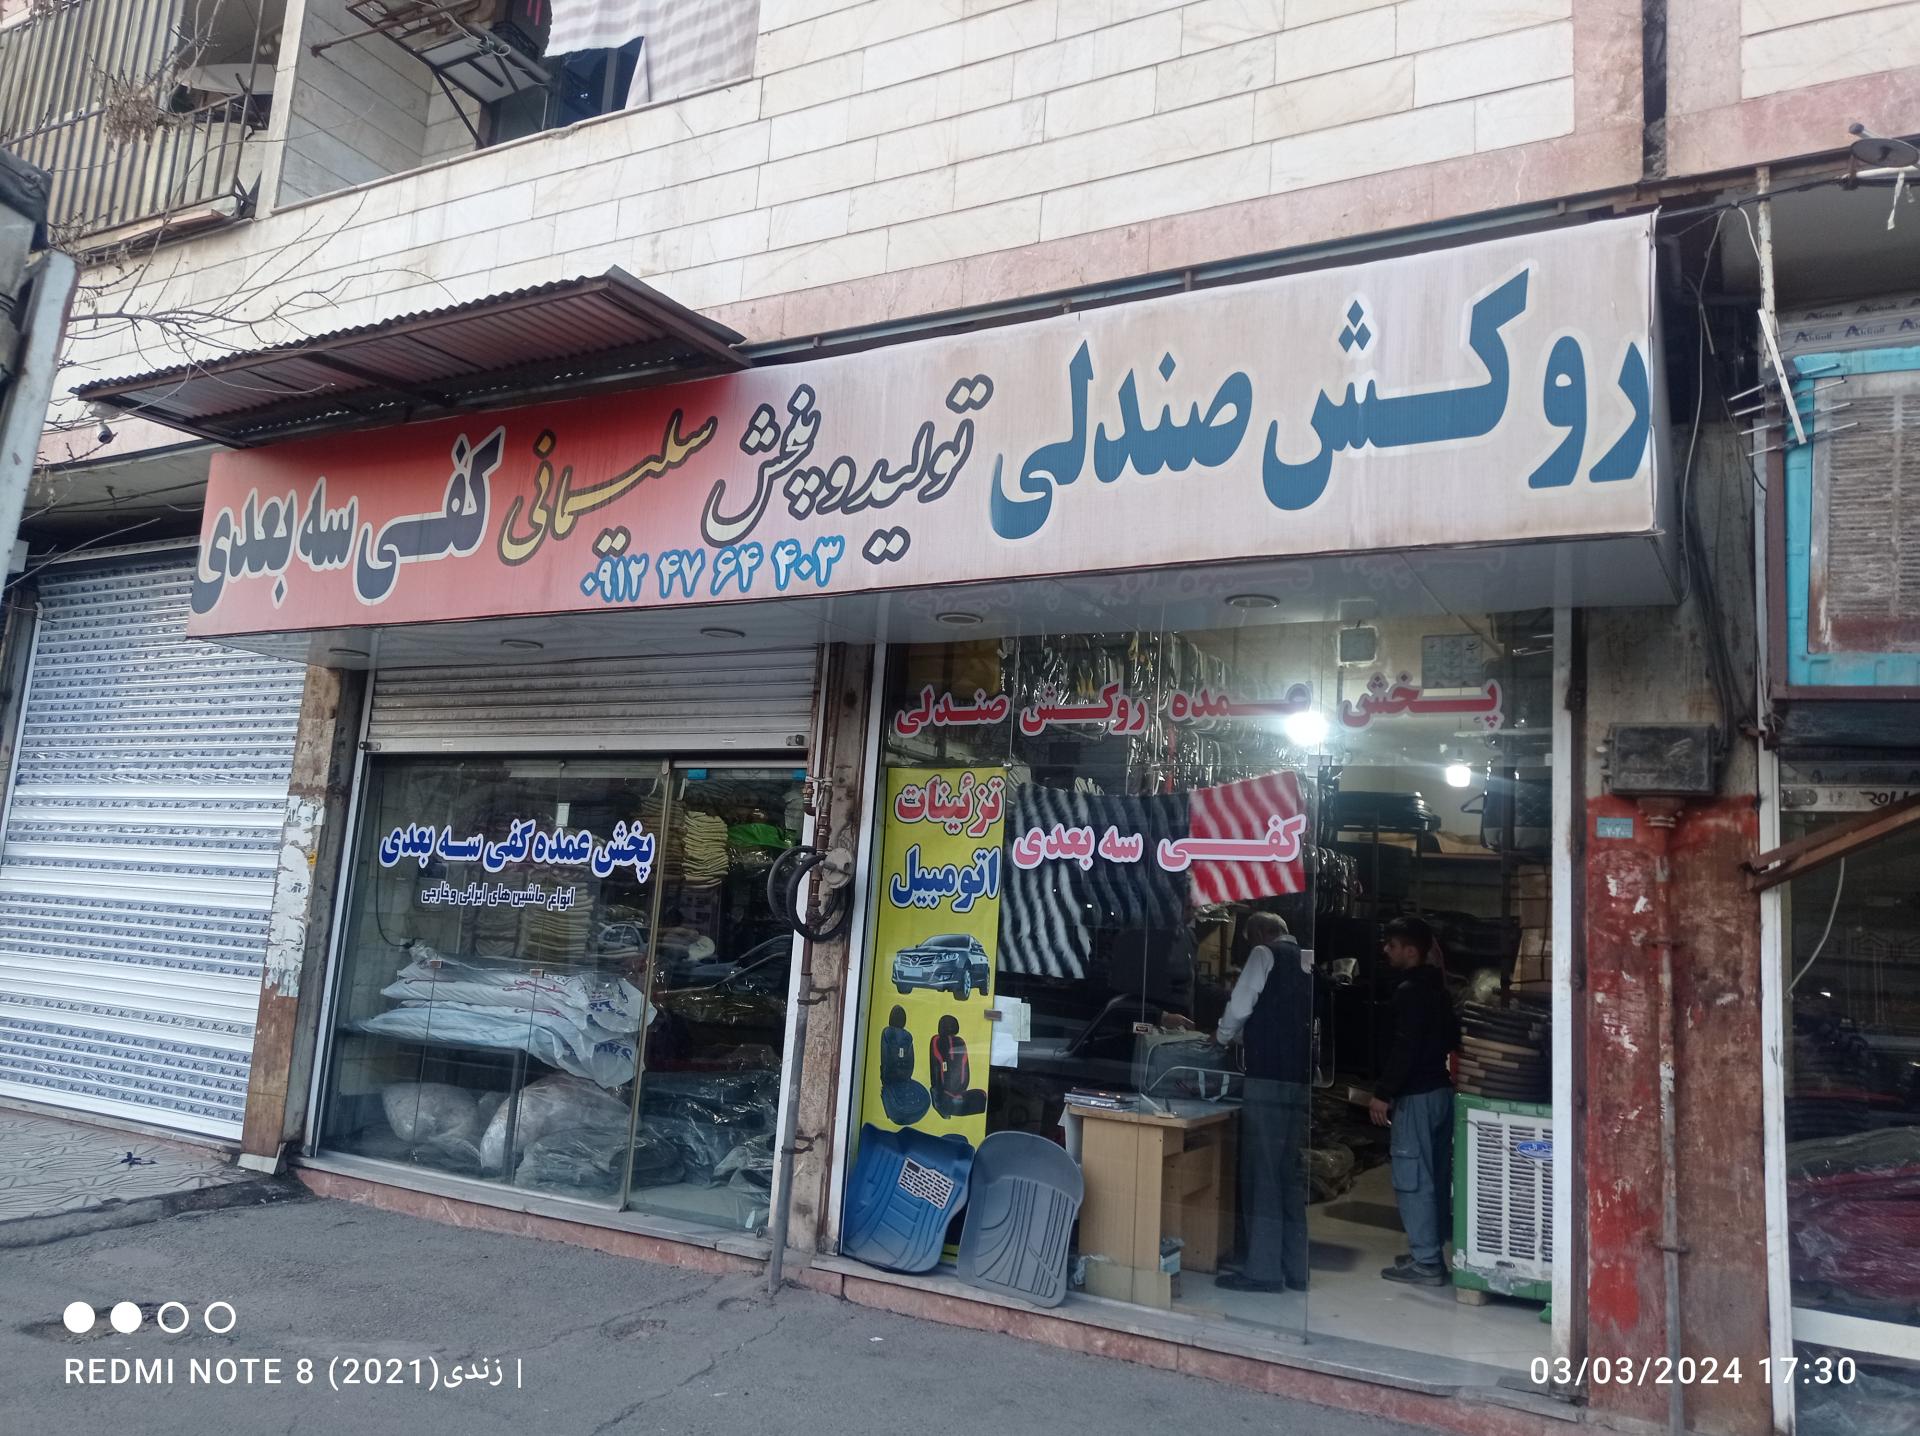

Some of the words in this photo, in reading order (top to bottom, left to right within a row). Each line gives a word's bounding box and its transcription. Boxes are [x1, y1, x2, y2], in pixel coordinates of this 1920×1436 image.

[1263, 266, 1650, 511] روکش
[989, 338, 1252, 541] صندلی
[497, 408, 717, 564] سلیمانی
[299, 476, 359, 572] سه
[356, 426, 505, 605] کفی
[190, 488, 298, 614] بعدی
[895, 683, 1010, 737] صندلی
[1019, 682, 1148, 736] روکش
[1338, 671, 1502, 733] پخش
[379, 823, 435, 868] بعدی
[436, 825, 483, 862] سه
[483, 818, 535, 872] کفی
[533, 828, 591, 864] عمده
[591, 820, 654, 883] پخش
[1012, 823, 1095, 870] بعدی
[1098, 826, 1144, 863] سه
[1157, 814, 1306, 873] کفی
[458, 883, 488, 905] ایرانی
[488, 883, 511, 906] های
[511, 883, 545, 908] ماشین
[546, 886, 575, 911] انواع
[890, 845, 1001, 912] اتومبیل
